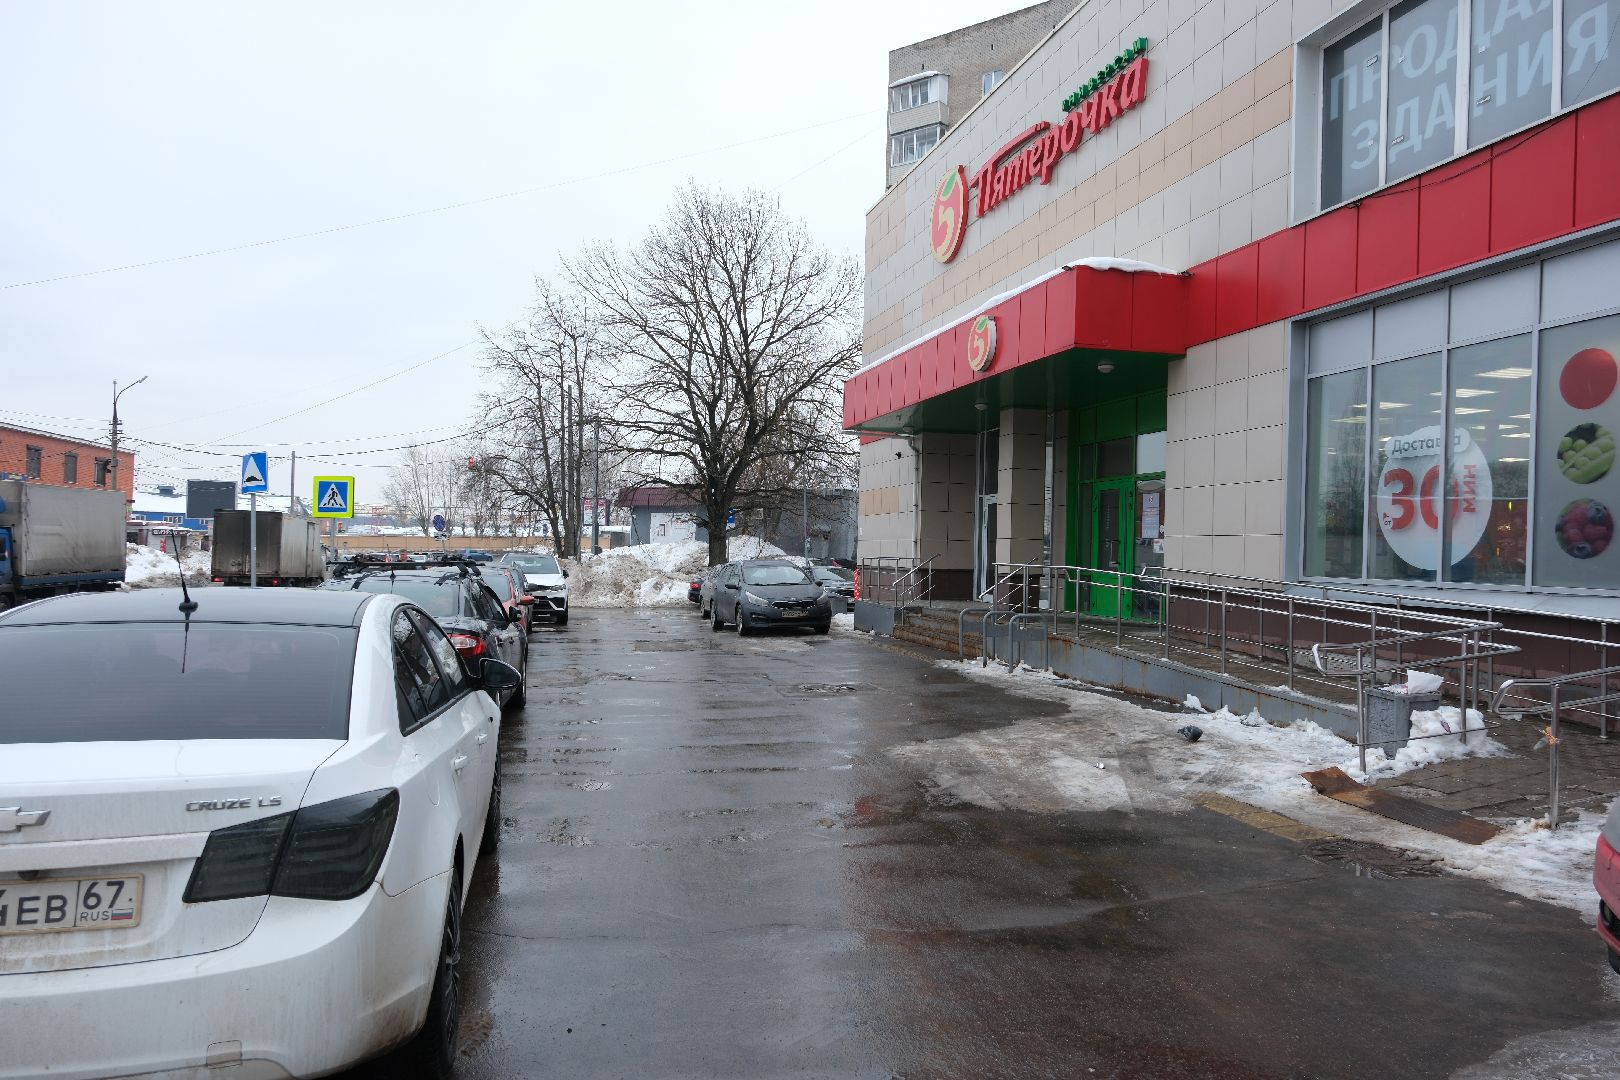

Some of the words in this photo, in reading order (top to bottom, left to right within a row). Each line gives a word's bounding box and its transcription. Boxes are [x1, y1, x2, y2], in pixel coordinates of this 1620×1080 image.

[1061, 37, 1148, 112] УНИВЕРСАМ
[1330, 0, 1553, 121] ПРОДА
[1350, 2, 1609, 170] ЗДАНИЯ
[1391, 433, 1461, 455] Достава
[1383, 464, 1461, 531] 30
[185, 797, 252, 812] CRUZE
[258, 795, 282, 808] LS
[79, 910, 110, 922] RUS
[83, 880, 125, 910] 67
